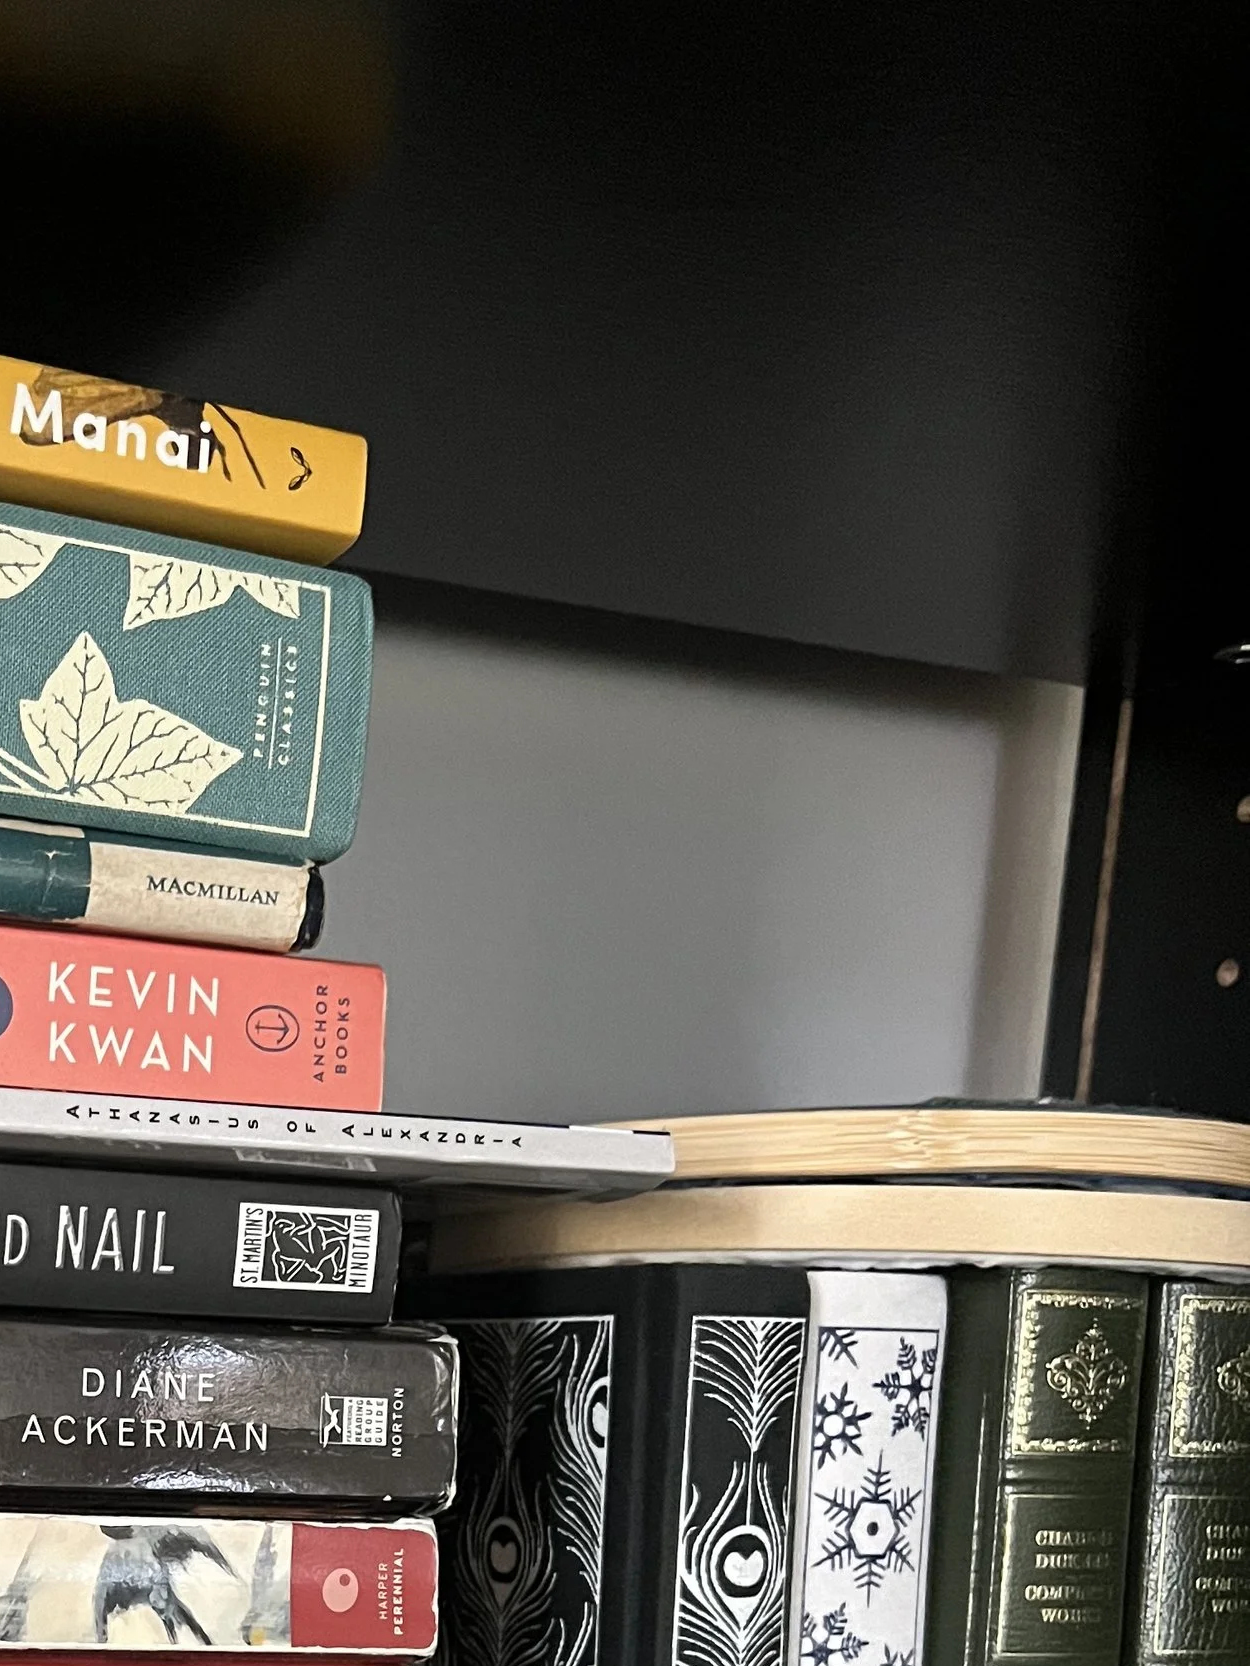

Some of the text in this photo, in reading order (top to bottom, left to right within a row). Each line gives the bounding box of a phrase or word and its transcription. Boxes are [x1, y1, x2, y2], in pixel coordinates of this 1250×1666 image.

[10, 383, 213, 475] Manai
[253, 643, 271, 758] PENGUIN
[278, 645, 297, 766] CLASSICS
[146, 874, 281, 906] MACMILLAN
[49, 961, 220, 1018] KEVIN
[49, 1022, 213, 1074] KWAN
[312, 984, 329, 1083] ANCHOR
[334, 997, 351, 1074] BOOKS
[66, 1104, 523, 1148] ATHANASIUS OF ALEXANDRIA
[55, 1204, 176, 1276] NAIL
[240, 1207, 264, 1284] ST. MARTIN'S
[348, 1213, 373, 1288] MINOTAUR
[82, 1366, 216, 1402] DIANE
[20, 1414, 269, 1452] ACKERMAN
[355, 1400, 364, 1442] READING
[365, 1400, 373, 1442] GROUP
[375, 1401, 384, 1443] GUIDE
[392, 1387, 404, 1457] NORTON
[378, 1562, 388, 1620] HARPER
[393, 1548, 404, 1635] PERENNIAL
